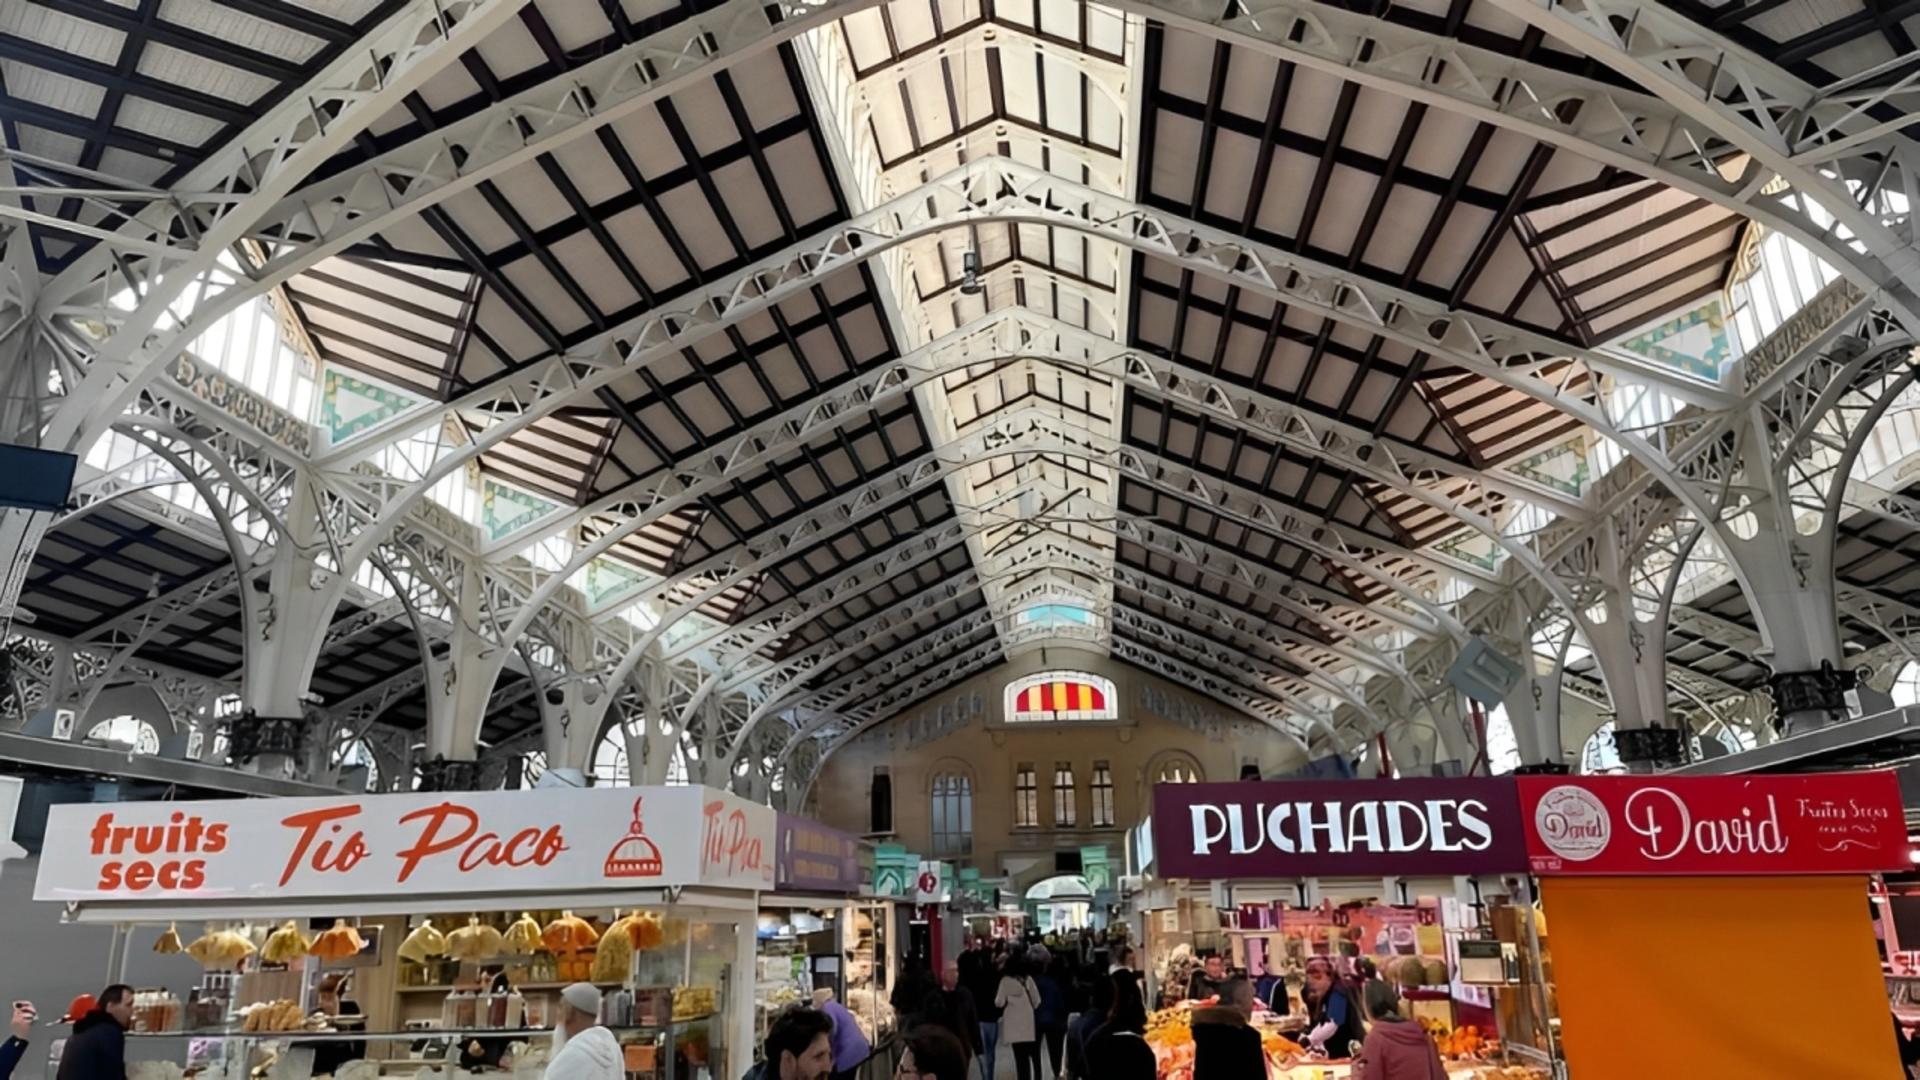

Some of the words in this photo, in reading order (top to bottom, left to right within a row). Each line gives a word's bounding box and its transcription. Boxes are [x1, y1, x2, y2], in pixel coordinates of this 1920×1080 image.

[90, 811, 230, 855] fruits
[279, 804, 373, 888] Tio
[396, 802, 571, 884] Paco
[1189, 799, 1492, 855] PUCHADES
[1624, 785, 1789, 861] David
[97, 859, 207, 892] secs
